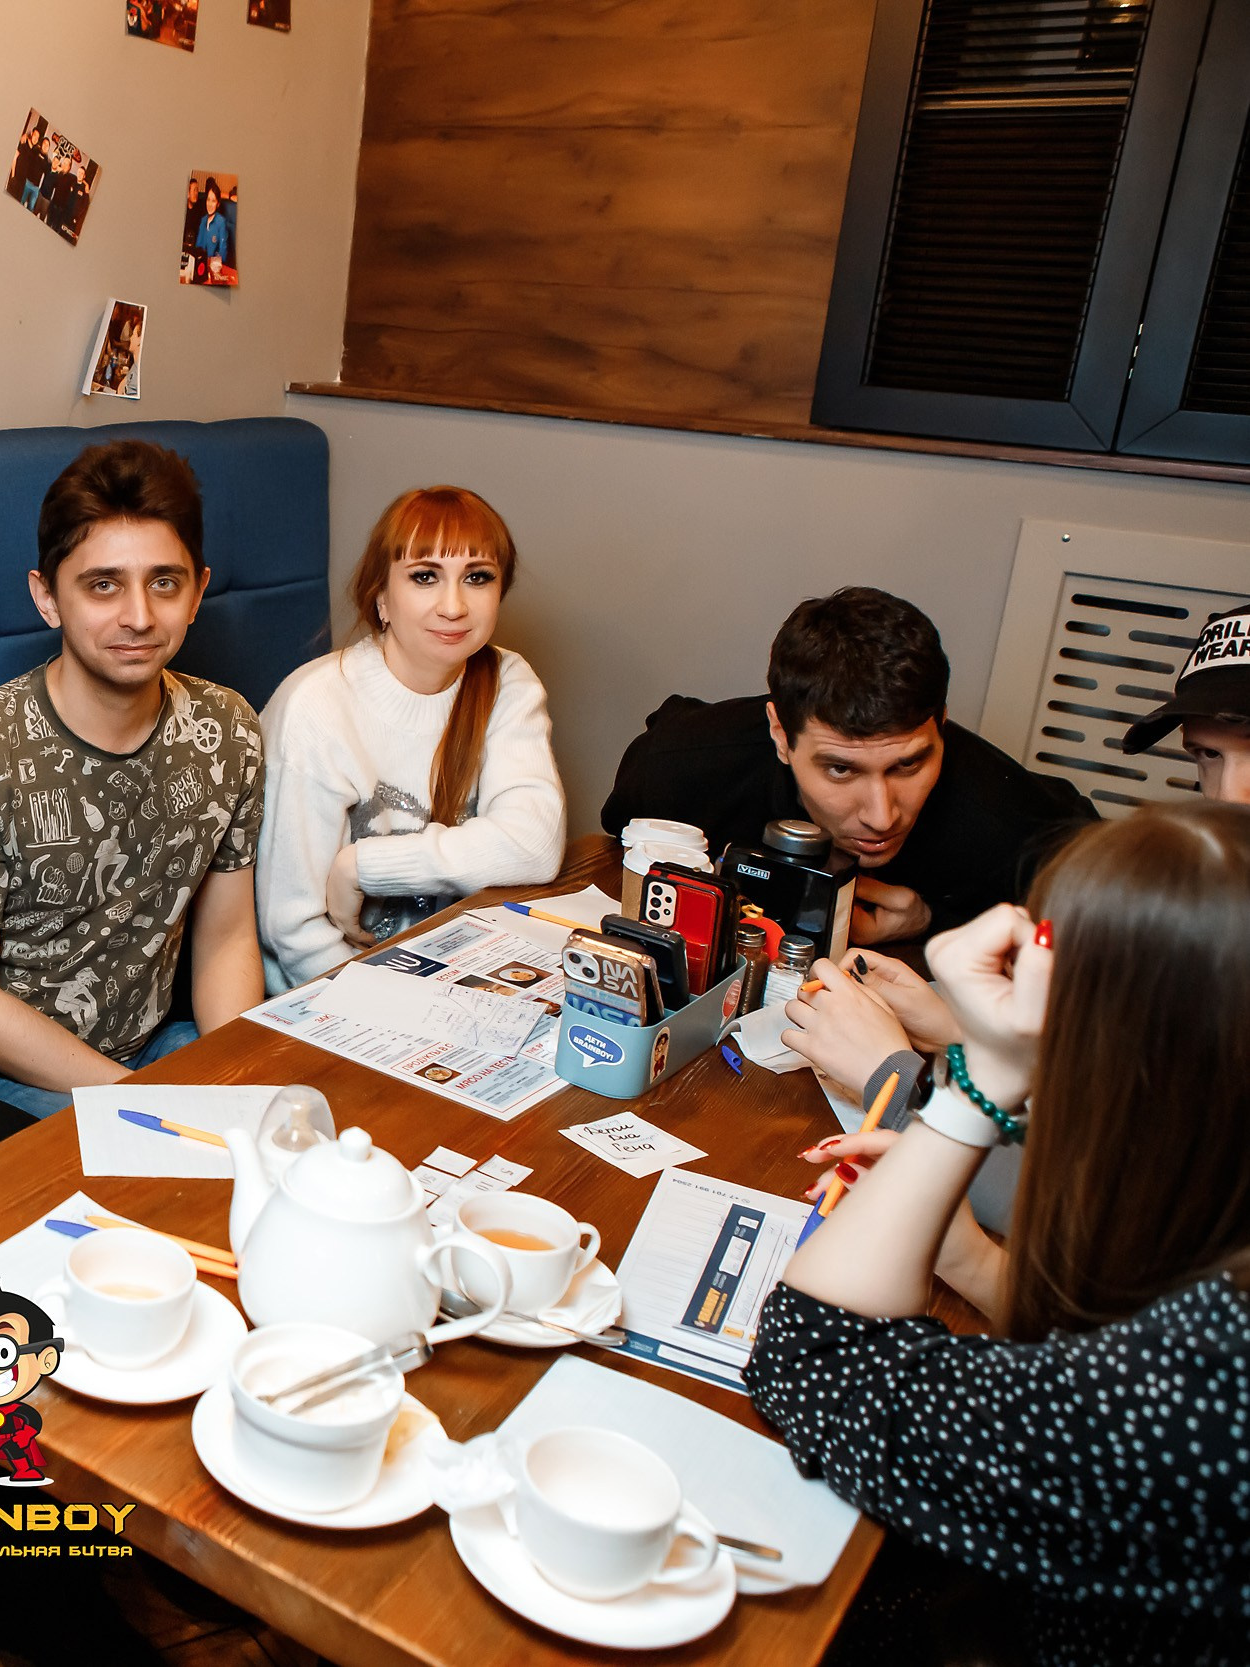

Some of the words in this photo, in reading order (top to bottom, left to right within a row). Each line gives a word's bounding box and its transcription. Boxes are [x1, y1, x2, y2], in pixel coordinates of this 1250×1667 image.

[1200, 620, 1250, 647] ORIL
[1194, 639, 1250, 667] WEAR
[378, 954, 422, 971] NU
[573, 1036, 614, 1062] BRAINBOY!
[584, 1034, 607, 1050] ДЕТИ
[401, 1048, 443, 1071] ПРОДУКТЫ
[455, 1073, 483, 1090] МЯСО
[480, 1067, 493, 1077] НА
